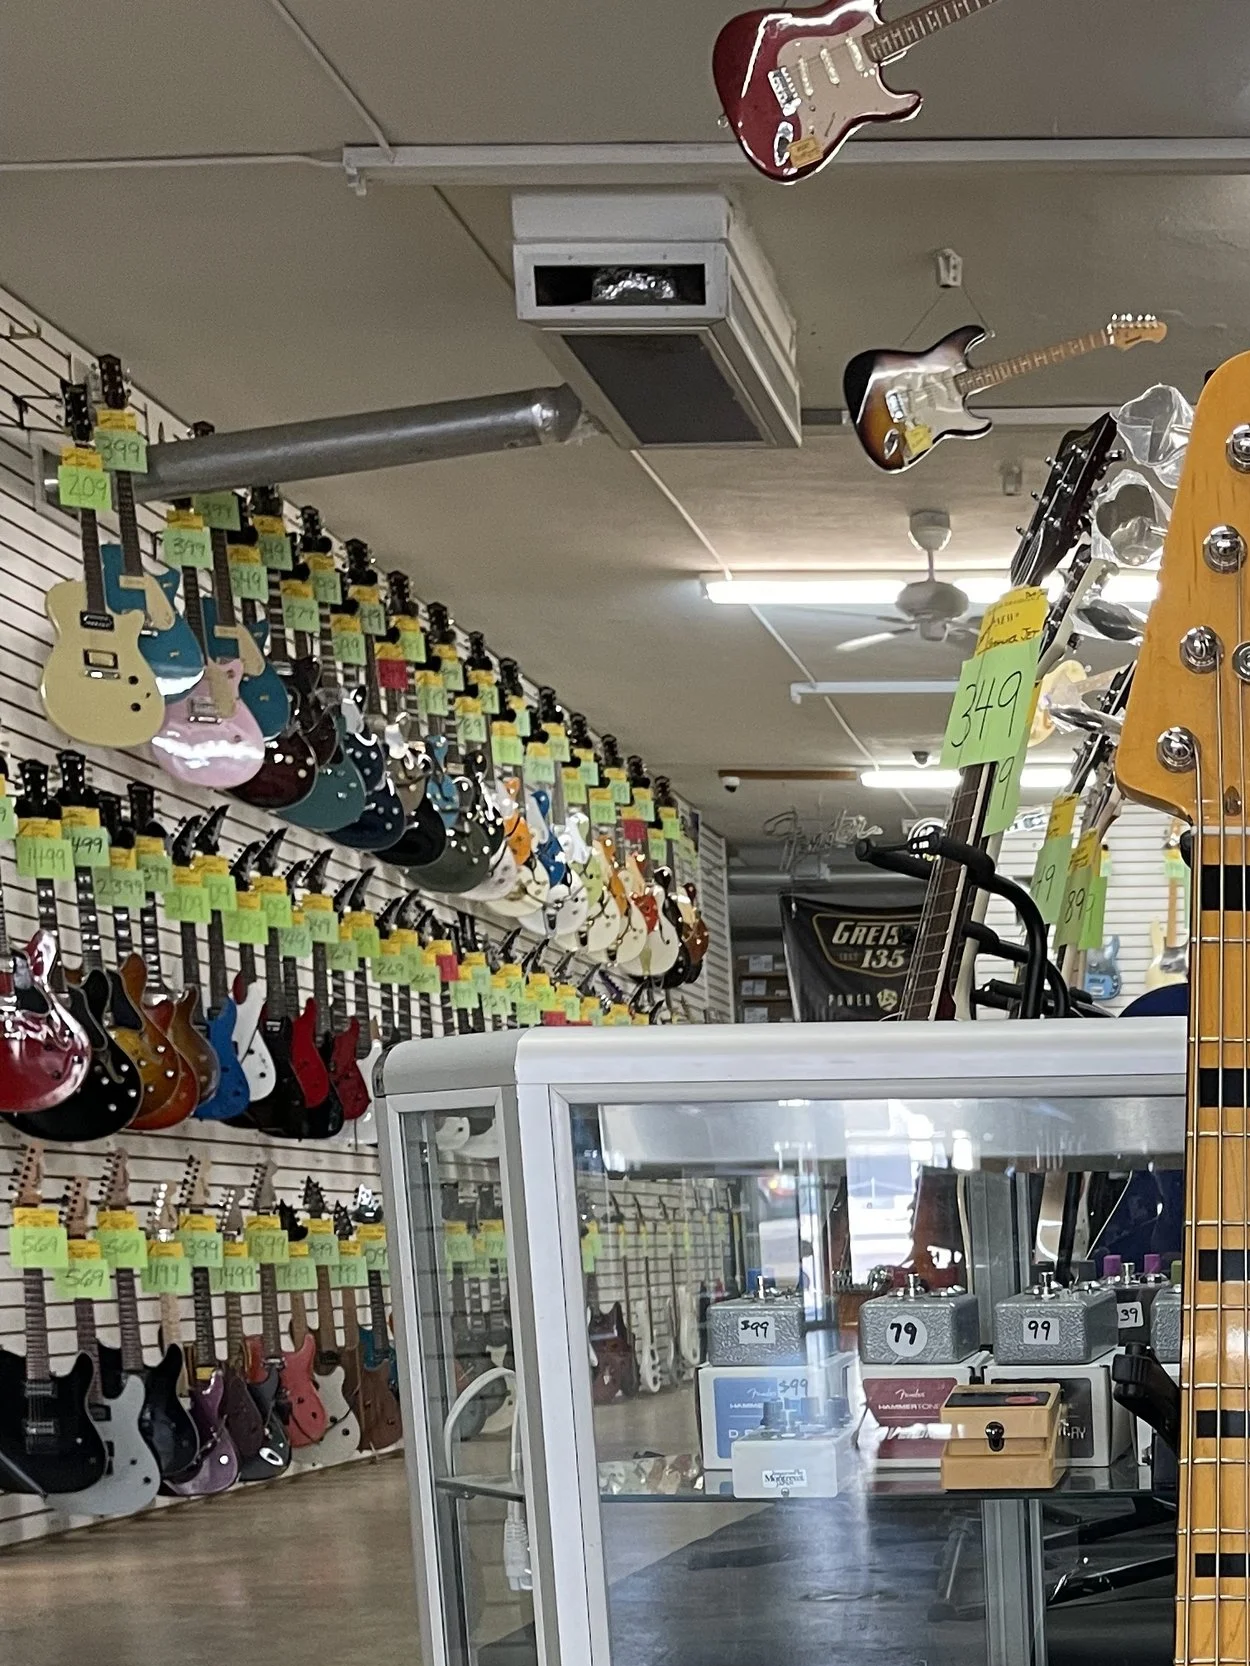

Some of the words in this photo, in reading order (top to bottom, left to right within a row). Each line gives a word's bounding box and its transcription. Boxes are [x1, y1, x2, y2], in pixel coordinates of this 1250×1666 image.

[950, 669, 1022, 748] 349
[831, 921, 917, 946] GRETS
[859, 949, 906, 969] 135
[1119, 1307, 1138, 1323] 39
[740, 1319, 769, 1338] $99
[889, 1321, 918, 1345] 79
[1027, 1320, 1051, 1340] 99
[778, 1378, 809, 1397] $99
[895, 1388, 926, 1400] Fender
